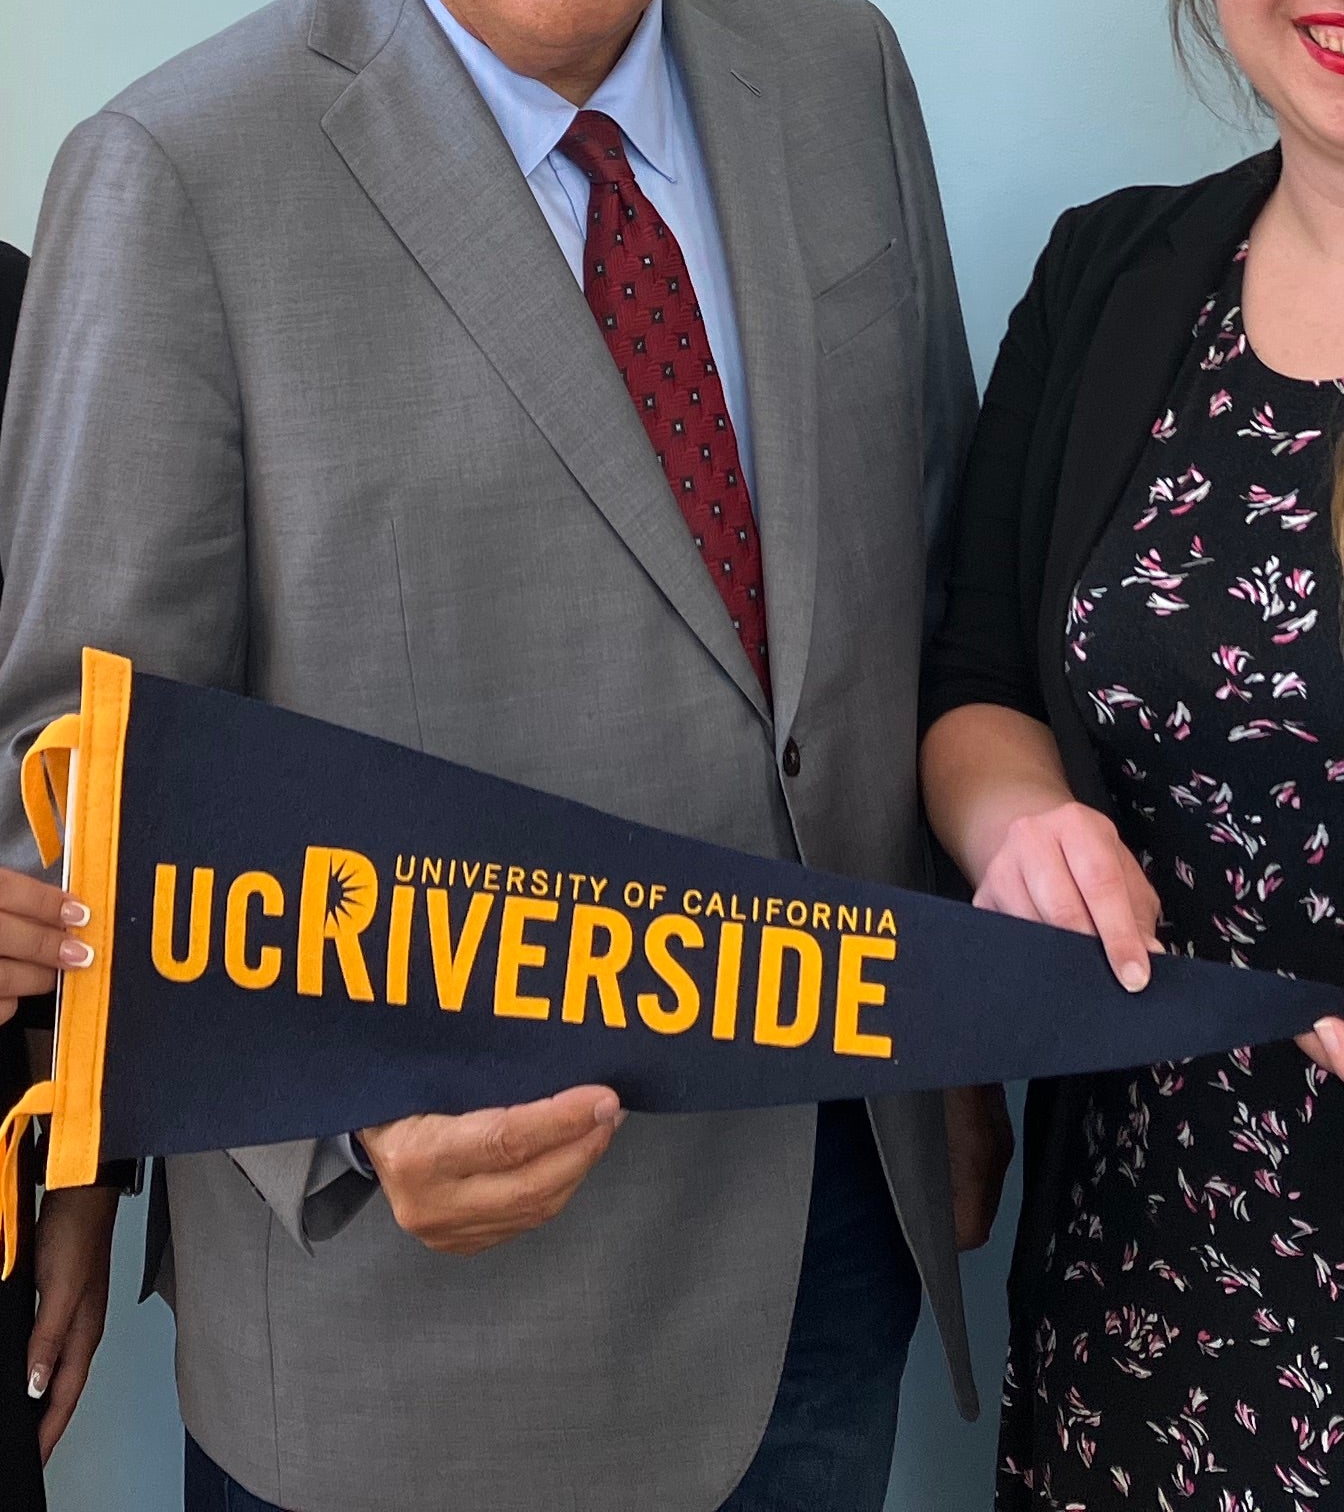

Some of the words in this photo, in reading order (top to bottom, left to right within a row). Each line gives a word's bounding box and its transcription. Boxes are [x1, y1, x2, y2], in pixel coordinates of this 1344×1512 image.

[395, 855, 609, 904] UNIVERSITY
[623, 880, 667, 910] OF
[683, 888, 898, 935] CALIFORNIA
